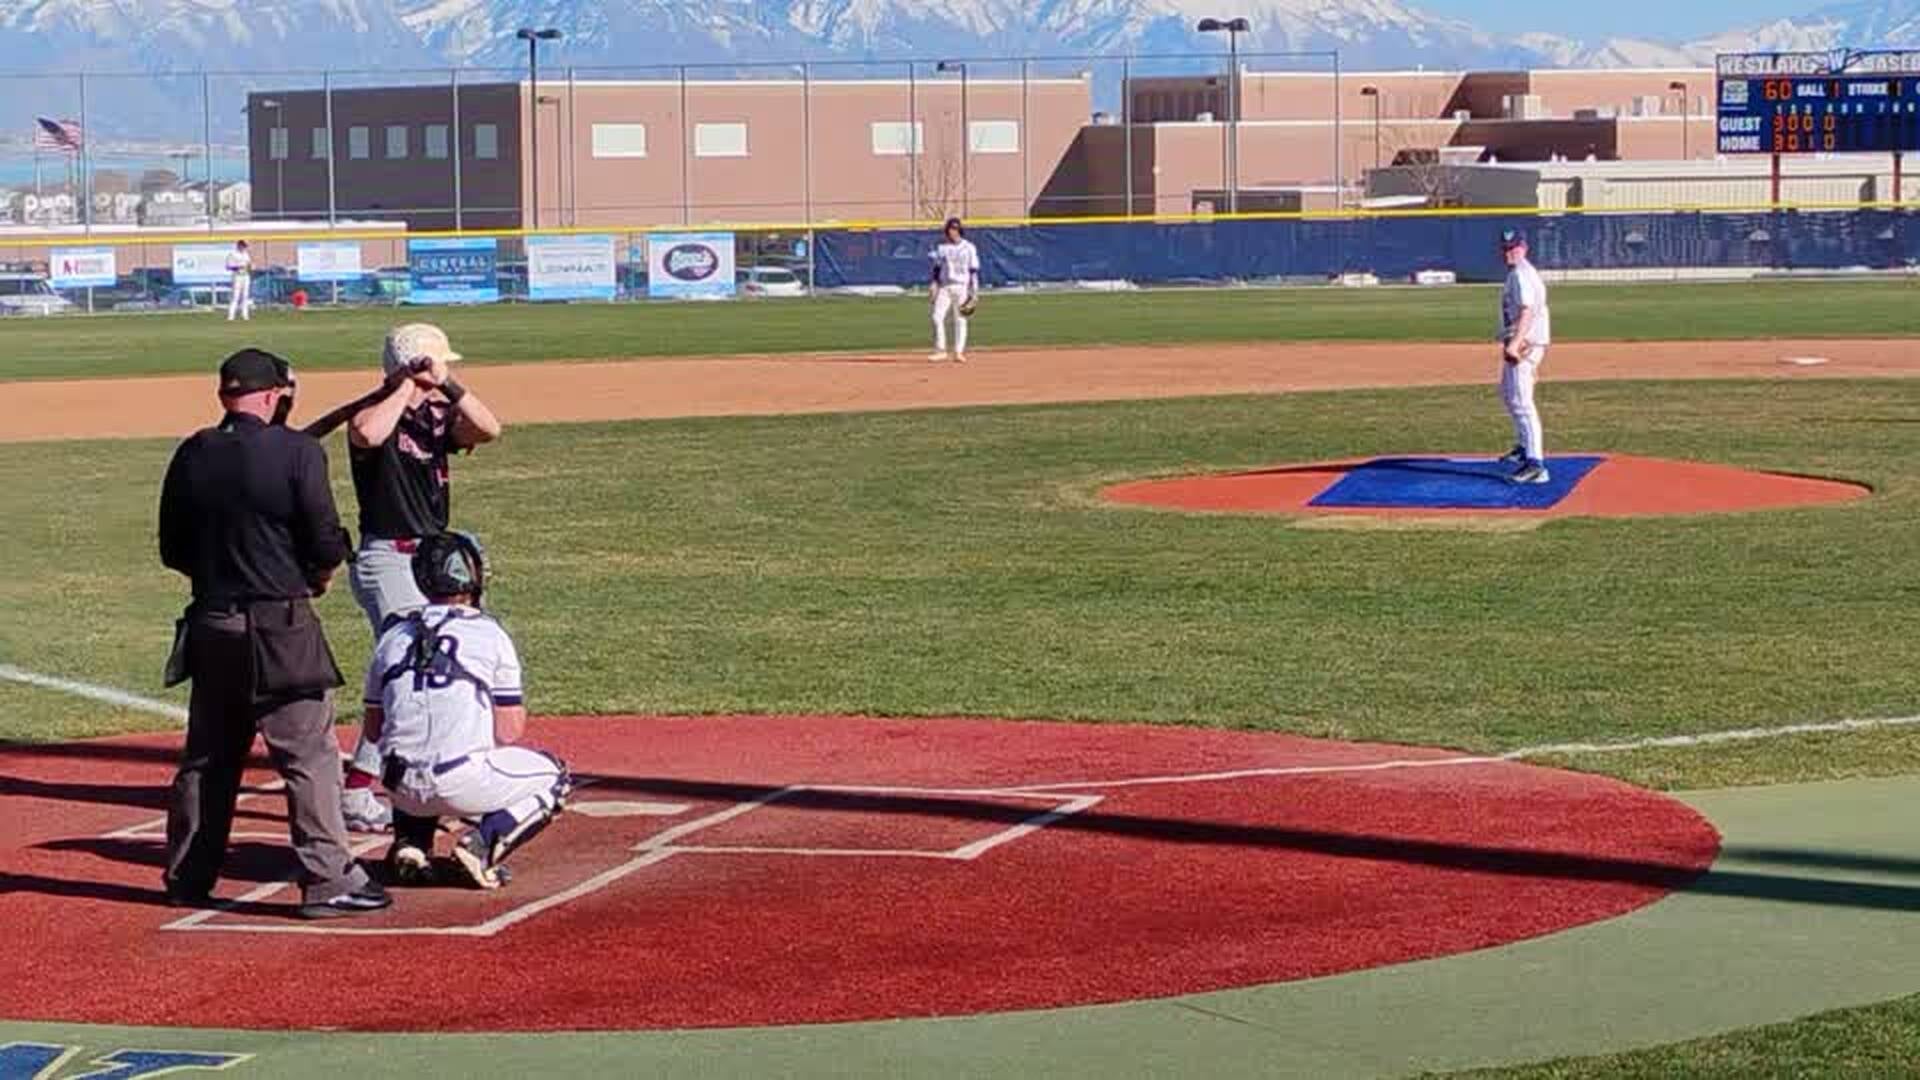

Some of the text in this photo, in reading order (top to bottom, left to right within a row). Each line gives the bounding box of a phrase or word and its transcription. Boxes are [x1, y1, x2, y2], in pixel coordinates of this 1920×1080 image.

[1718, 55, 1814, 74] WESTLAKE
[1764, 80, 1793, 101] 60
[1797, 83, 1825, 96] BALL
[1719, 116, 1762, 132] GUEST
[1787, 116, 1799, 132] 0
[1803, 116, 1814, 131] 0
[1823, 115, 1835, 131] 0
[1719, 135, 1761, 151] HOME
[1787, 134, 1799, 150] 0
[1823, 133, 1835, 150] 0
